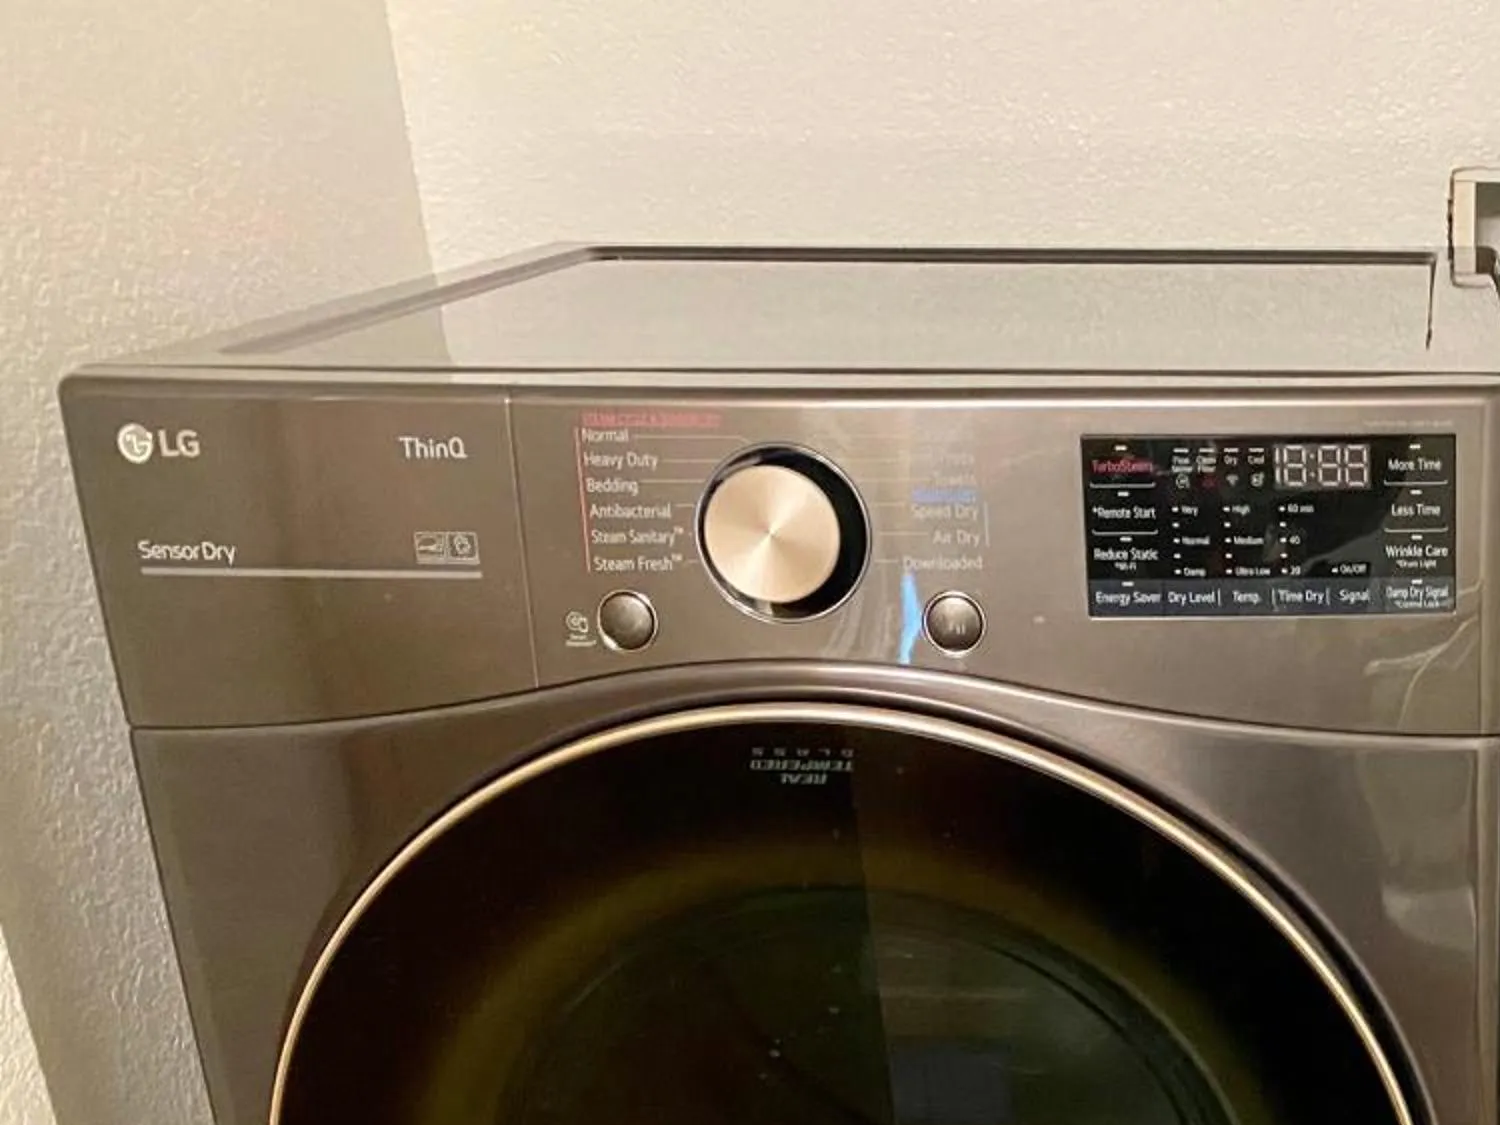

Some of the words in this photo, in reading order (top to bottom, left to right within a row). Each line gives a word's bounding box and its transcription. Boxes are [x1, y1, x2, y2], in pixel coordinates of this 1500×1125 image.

[582, 428, 629, 443] Normal
[399, 436, 467, 460] ThinQ
[584, 452, 623, 470] Heavy
[626, 451, 658, 470] Duty
[1388, 458, 1415, 471] More
[1418, 458, 1442, 471] Time
[586, 477, 638, 496] Bedding
[590, 503, 672, 519] Antibacterial
[1133, 505, 1157, 519] Start
[1391, 503, 1414, 517] Less
[1416, 503, 1441, 516] Time
[592, 529, 626, 545] Steam
[956, 528, 980, 548] Dry
[1094, 548, 1129, 561] Reduce
[1131, 547, 1159, 561] Static
[1386, 544, 1423, 558] Wrinkle
[1425, 544, 1449, 557] Care
[594, 555, 634, 572] Steam
[1168, 591, 1187, 607] Dry
[1305, 589, 1325, 605] Dry
[1339, 588, 1370, 605] Signal
